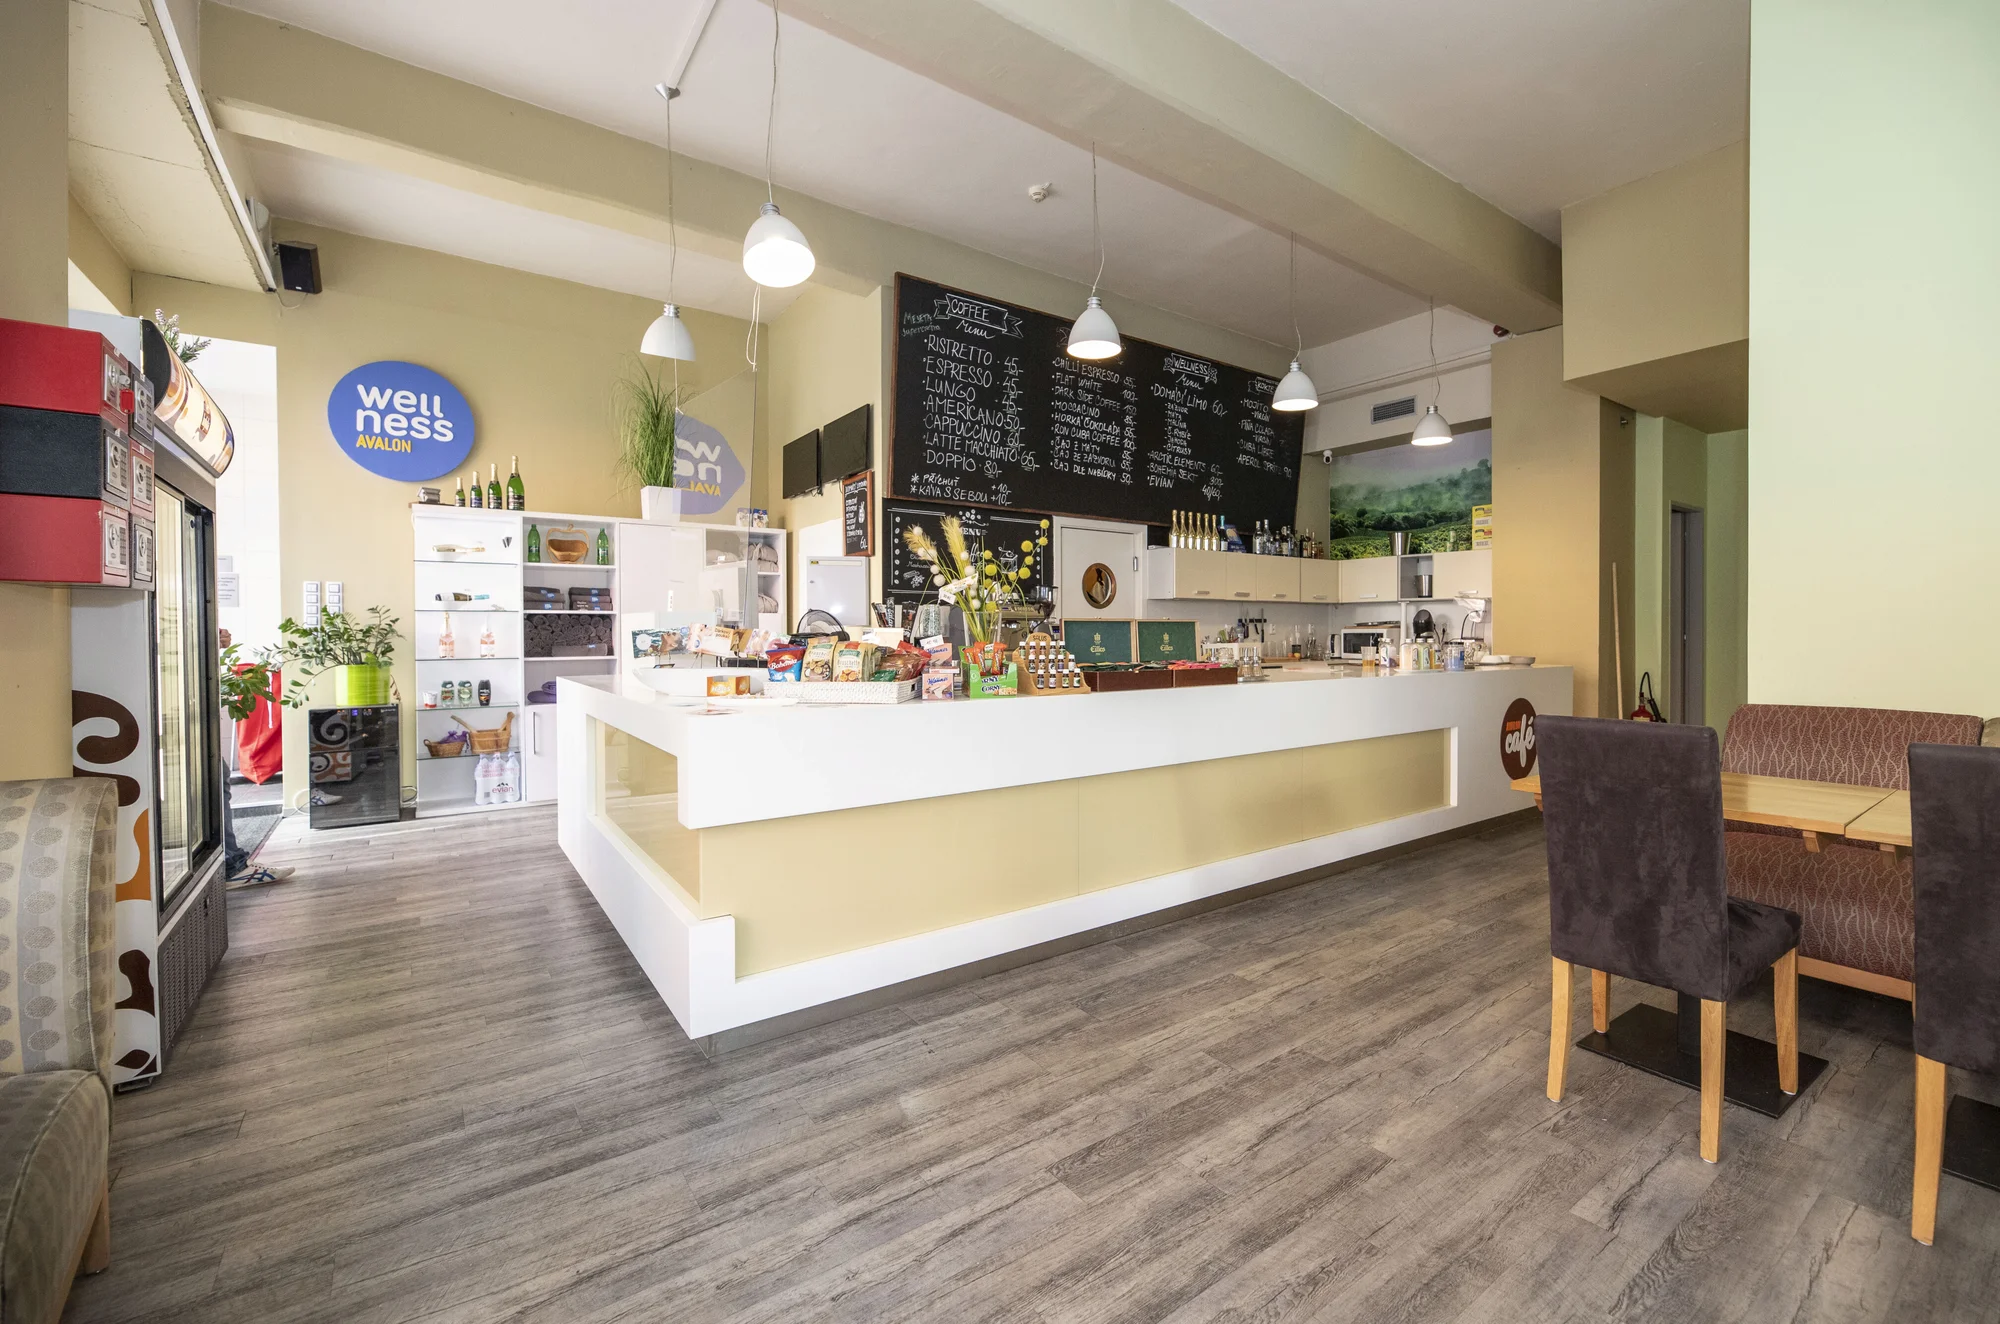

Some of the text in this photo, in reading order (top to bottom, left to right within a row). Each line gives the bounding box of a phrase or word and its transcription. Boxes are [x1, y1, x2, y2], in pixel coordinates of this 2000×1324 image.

[951, 299, 990, 322] COFFEE
[956, 320, 996, 339] Menu
[928, 335, 992, 365] RISTRETTO
[926, 356, 992, 387] ESPRESSO
[1081, 364, 1120, 384] ESPRESSO
[1173, 356, 1208, 375] WELLNESS
[1055, 372, 1076, 385] FLAT
[926, 376, 976, 402] LUNGO
[356, 384, 444, 418] well
[1054, 386, 1075, 400] DARK
[1095, 395, 1121, 413] COFFEE
[356, 408, 454, 442] ness
[356, 434, 412, 453] AVALON
[925, 432, 962, 451] LATTE
[1054, 423, 1069, 436] RON
[1071, 427, 1090, 440] CUBA
[1091, 431, 1121, 447] COFFEE
[1054, 435, 1071, 449] ČAJ
[1053, 447, 1069, 459] ČAJ
[1053, 458, 1069, 471] ČAJ
[1073, 464, 1086, 475] DLE
[1173, 456, 1206, 473] ELEMENTS
[771, 658, 798, 670] Bohemia
[1505, 714, 1536, 768] café
[491, 785, 514, 793] evian
